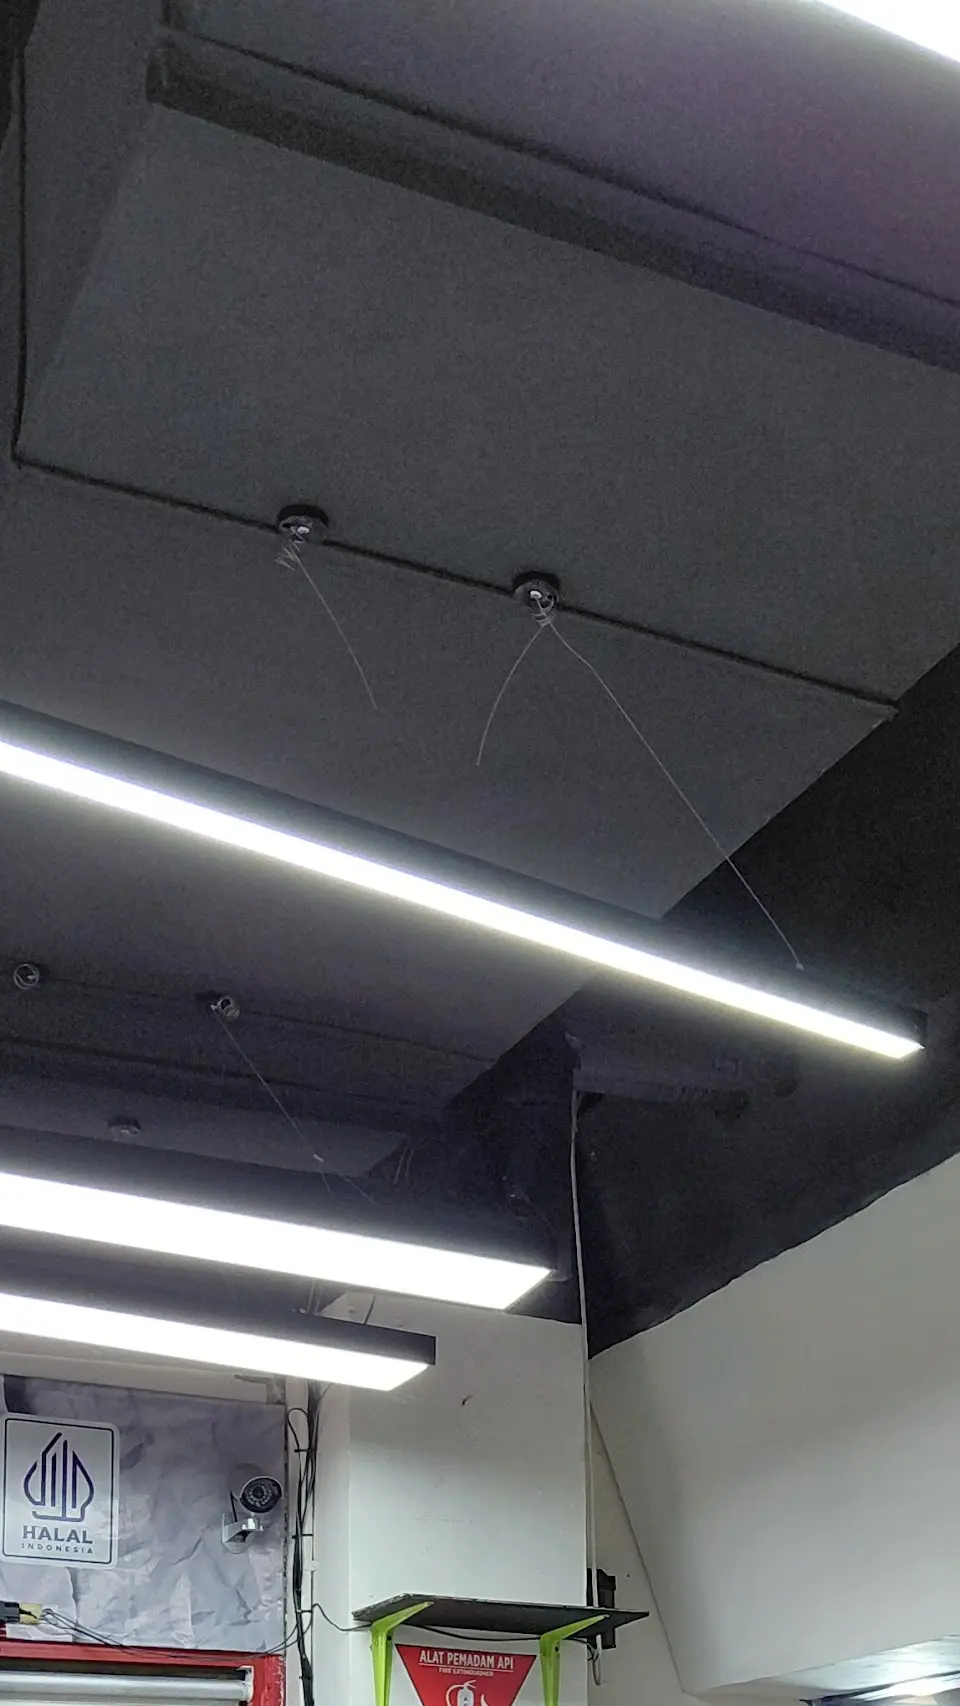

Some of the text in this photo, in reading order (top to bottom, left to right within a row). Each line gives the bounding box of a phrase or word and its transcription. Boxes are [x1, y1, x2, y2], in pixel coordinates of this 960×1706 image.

[22, 1525, 93, 1544] HALAL
[21, 1543, 93, 1554] INDONESIA
[420, 1650, 514, 1669] ALAT PEMADAM API
